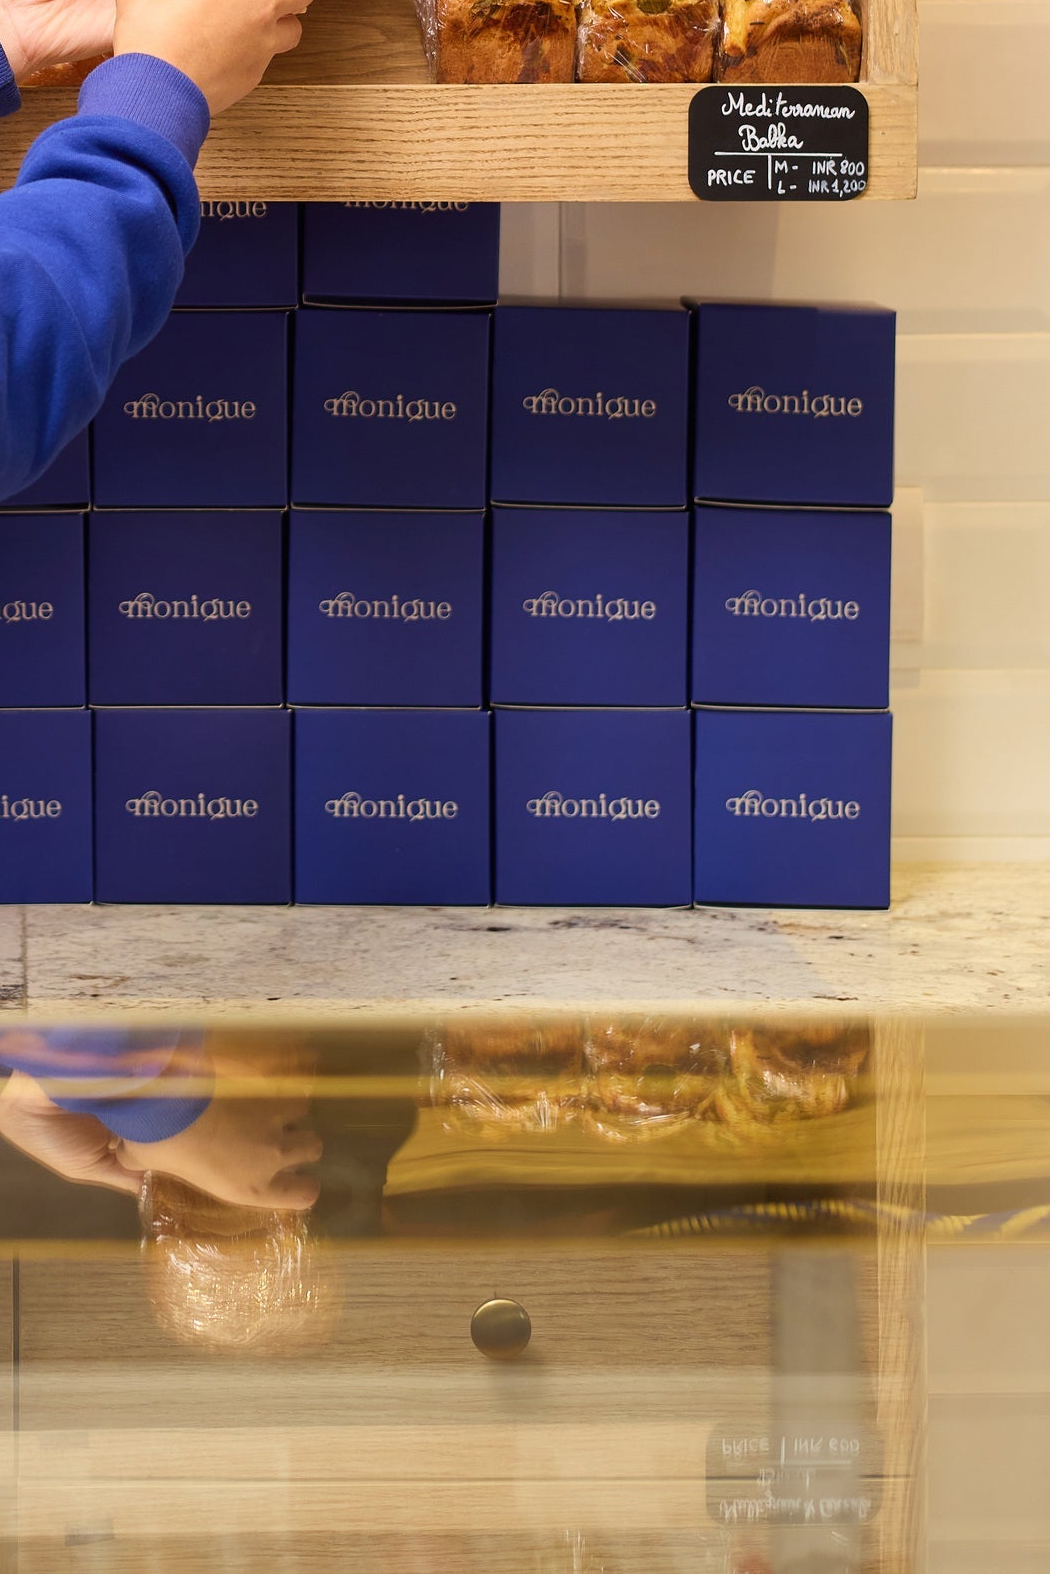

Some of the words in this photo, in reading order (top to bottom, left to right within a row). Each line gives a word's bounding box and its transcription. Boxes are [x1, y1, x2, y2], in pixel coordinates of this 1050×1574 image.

[721, 92, 856, 119] Mediterranean
[738, 122, 804, 152] Babka
[707, 169, 756, 187] PRICE
[812, 160, 837, 176] INR
[840, 160, 865, 176] 800
[808, 180, 829, 194] INR
[831, 178, 867, 197] 1,200
[124, 393, 256, 422] monique
[324, 391, 456, 421] monique
[523, 388, 656, 419] monique
[728, 386, 863, 418] monique
[119, 592, 251, 621] monique
[319, 592, 452, 621] monique
[523, 591, 656, 621] monique
[725, 590, 859, 621] monique
[126, 791, 258, 821] monique
[325, 792, 458, 822] monique
[526, 791, 660, 821] monique
[726, 790, 860, 821] monique
